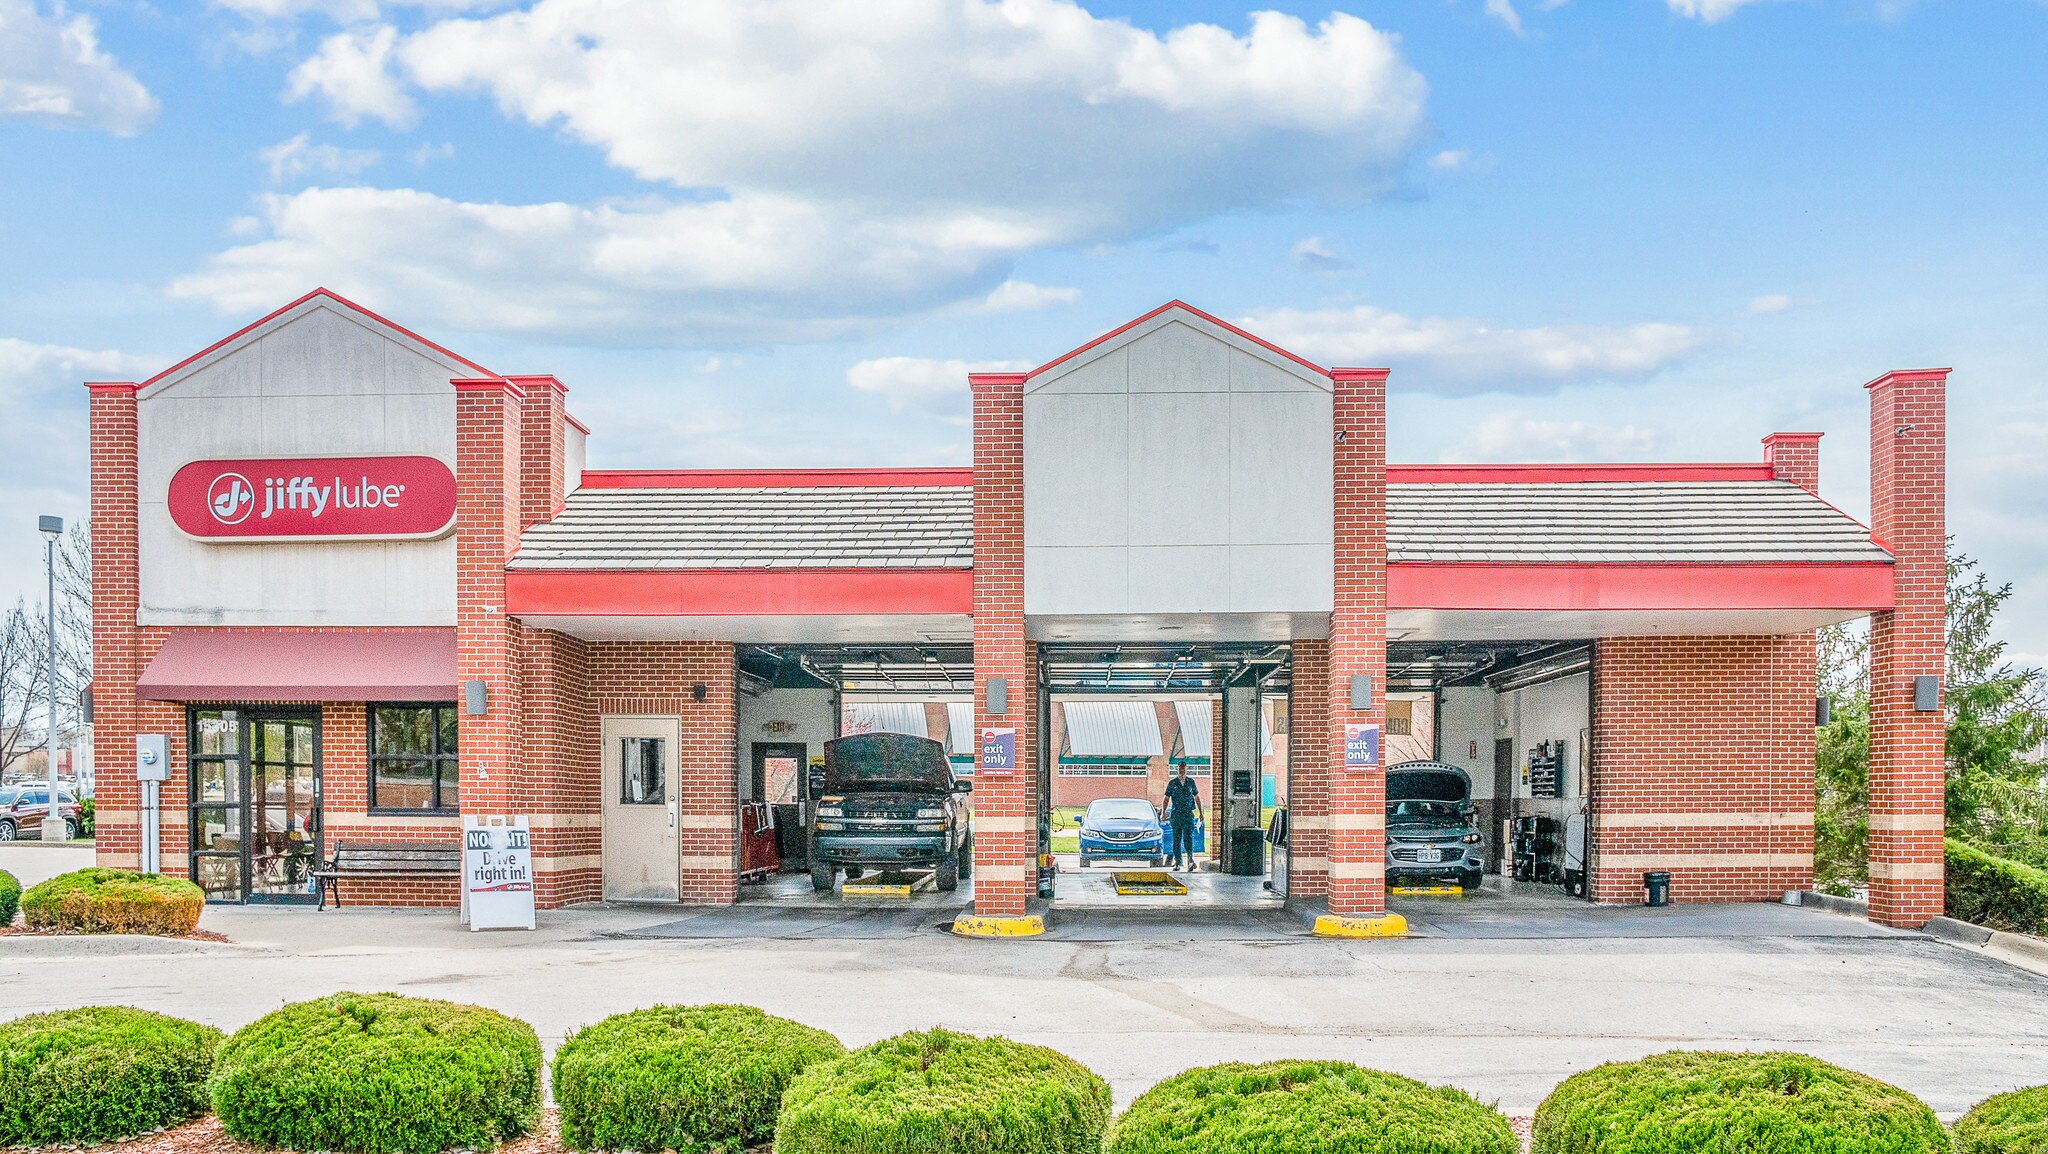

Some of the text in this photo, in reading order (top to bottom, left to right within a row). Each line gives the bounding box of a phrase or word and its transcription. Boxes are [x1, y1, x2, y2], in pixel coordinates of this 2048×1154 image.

[261, 476, 401, 519] jiffy lube
[984, 744, 1003, 753] exit
[1347, 740, 1367, 749] exit
[984, 754, 1007, 765] only
[1347, 750, 1370, 761] only
[469, 832, 488, 847] NO
[483, 851, 516, 865] Dive
[475, 866, 526, 884] right in!
